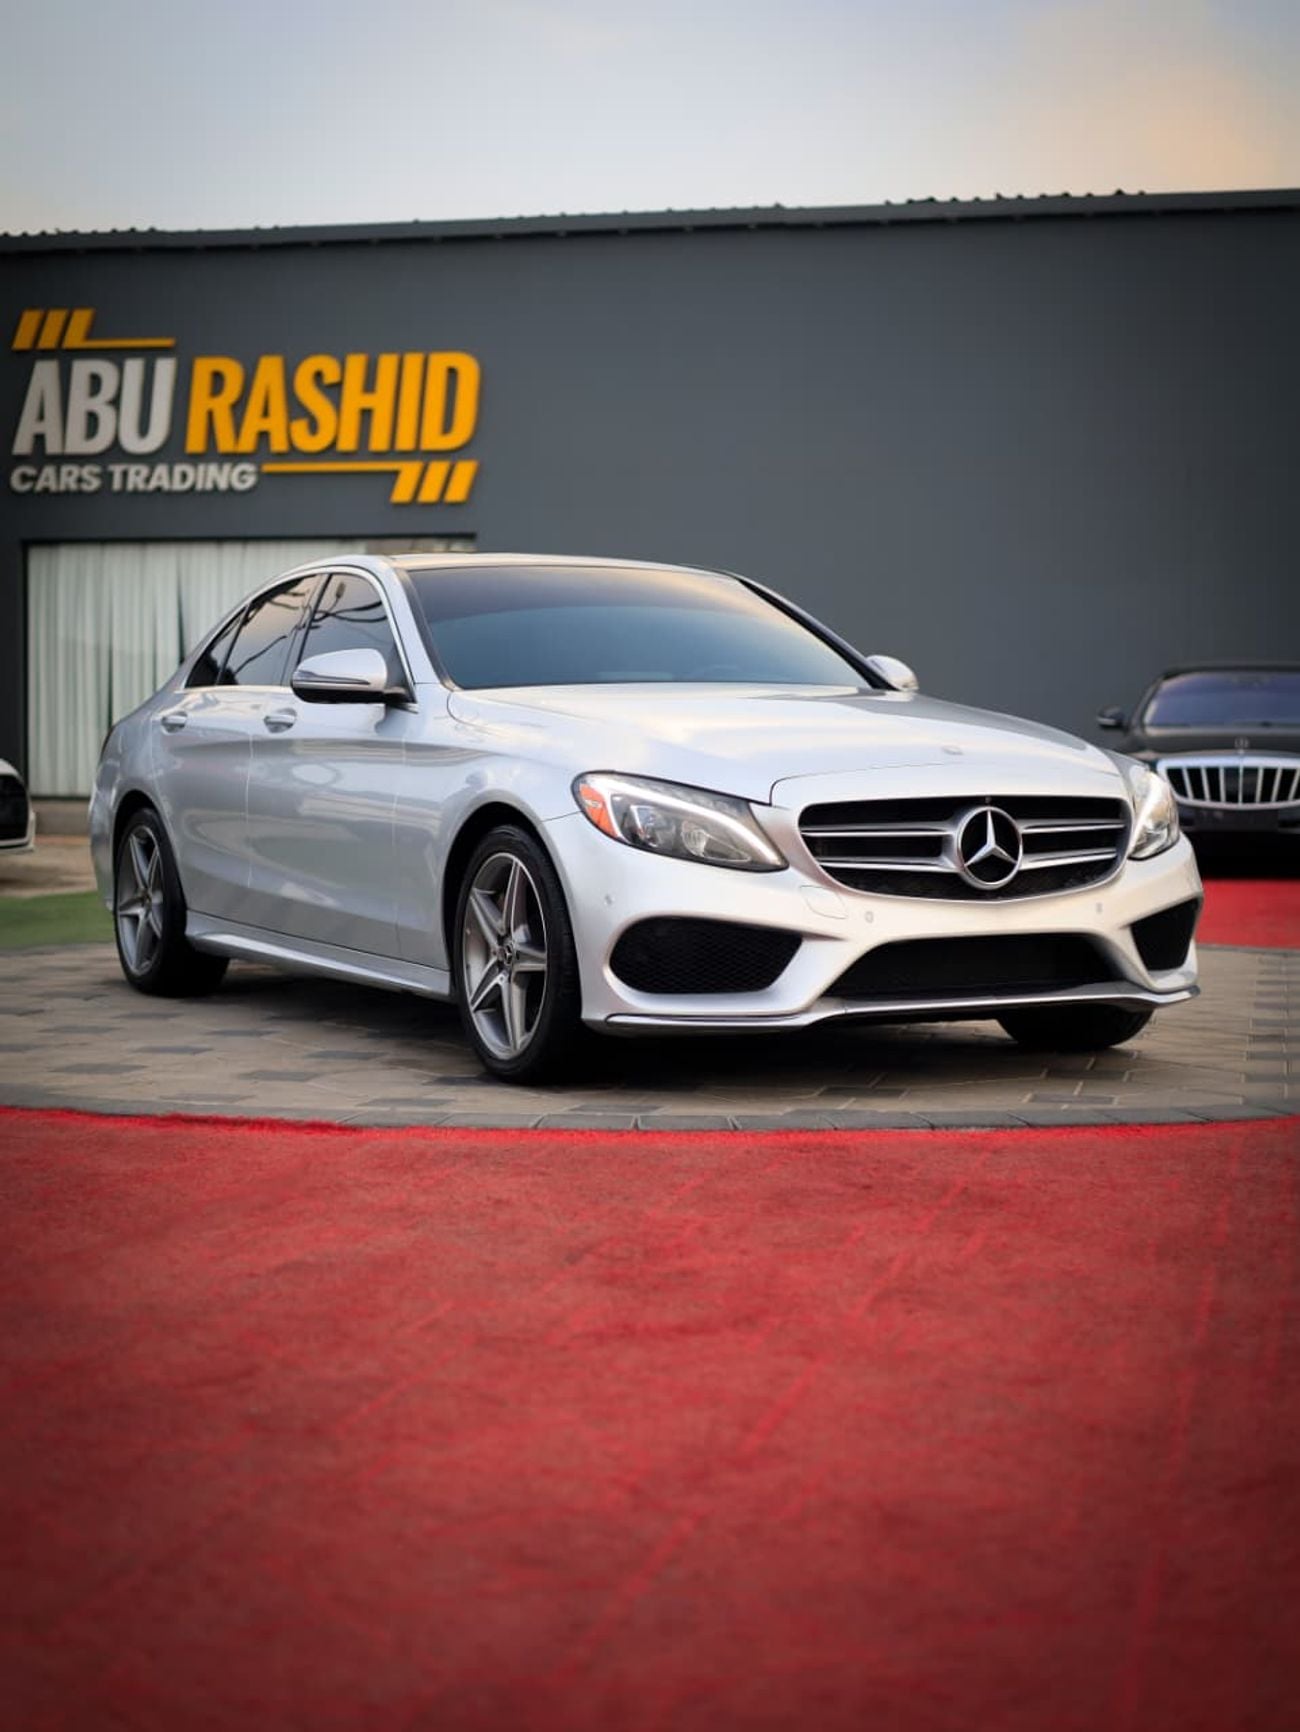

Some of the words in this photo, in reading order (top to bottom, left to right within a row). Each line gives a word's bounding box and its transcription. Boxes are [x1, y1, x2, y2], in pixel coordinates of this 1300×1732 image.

[12, 357, 177, 455] ABU
[185, 352, 480, 454] RASHID
[10, 464, 101, 492] CARS
[107, 463, 257, 492] TRADING
